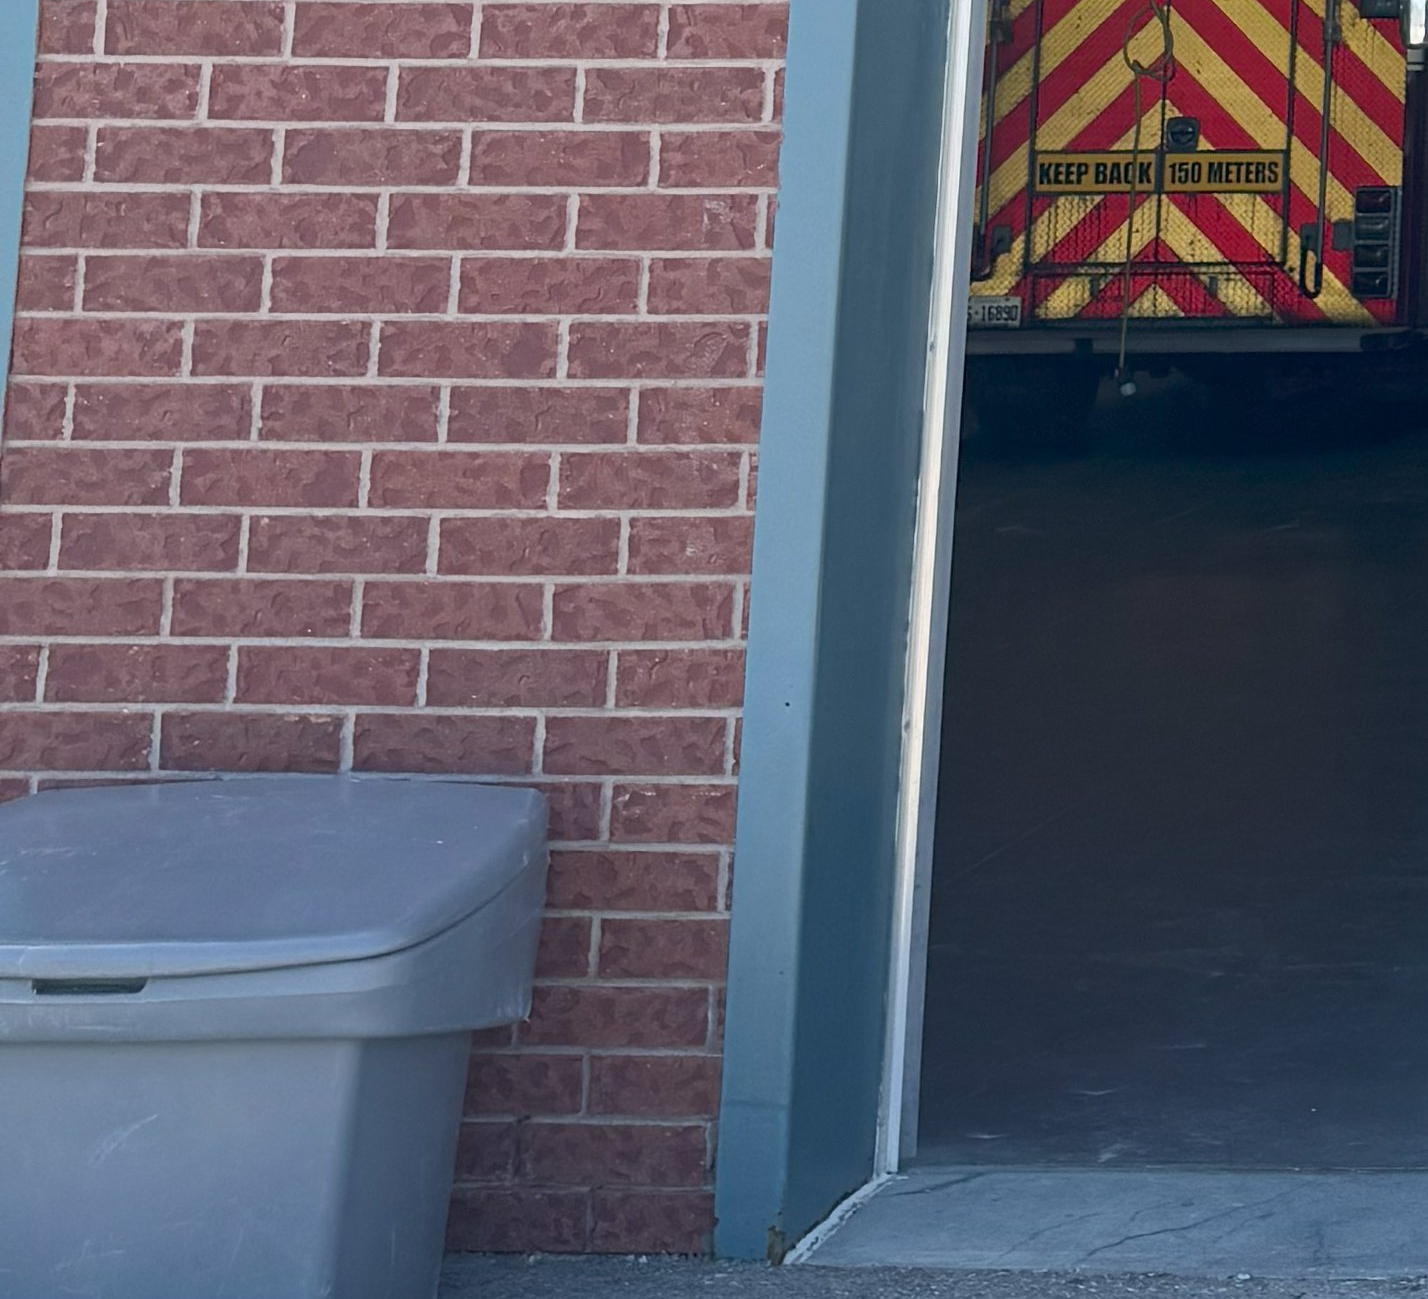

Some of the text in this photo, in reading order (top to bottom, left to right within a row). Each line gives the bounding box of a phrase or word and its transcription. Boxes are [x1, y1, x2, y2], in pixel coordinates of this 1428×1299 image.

[1038, 161, 1279, 185] KEEP BACK 150 METERS
